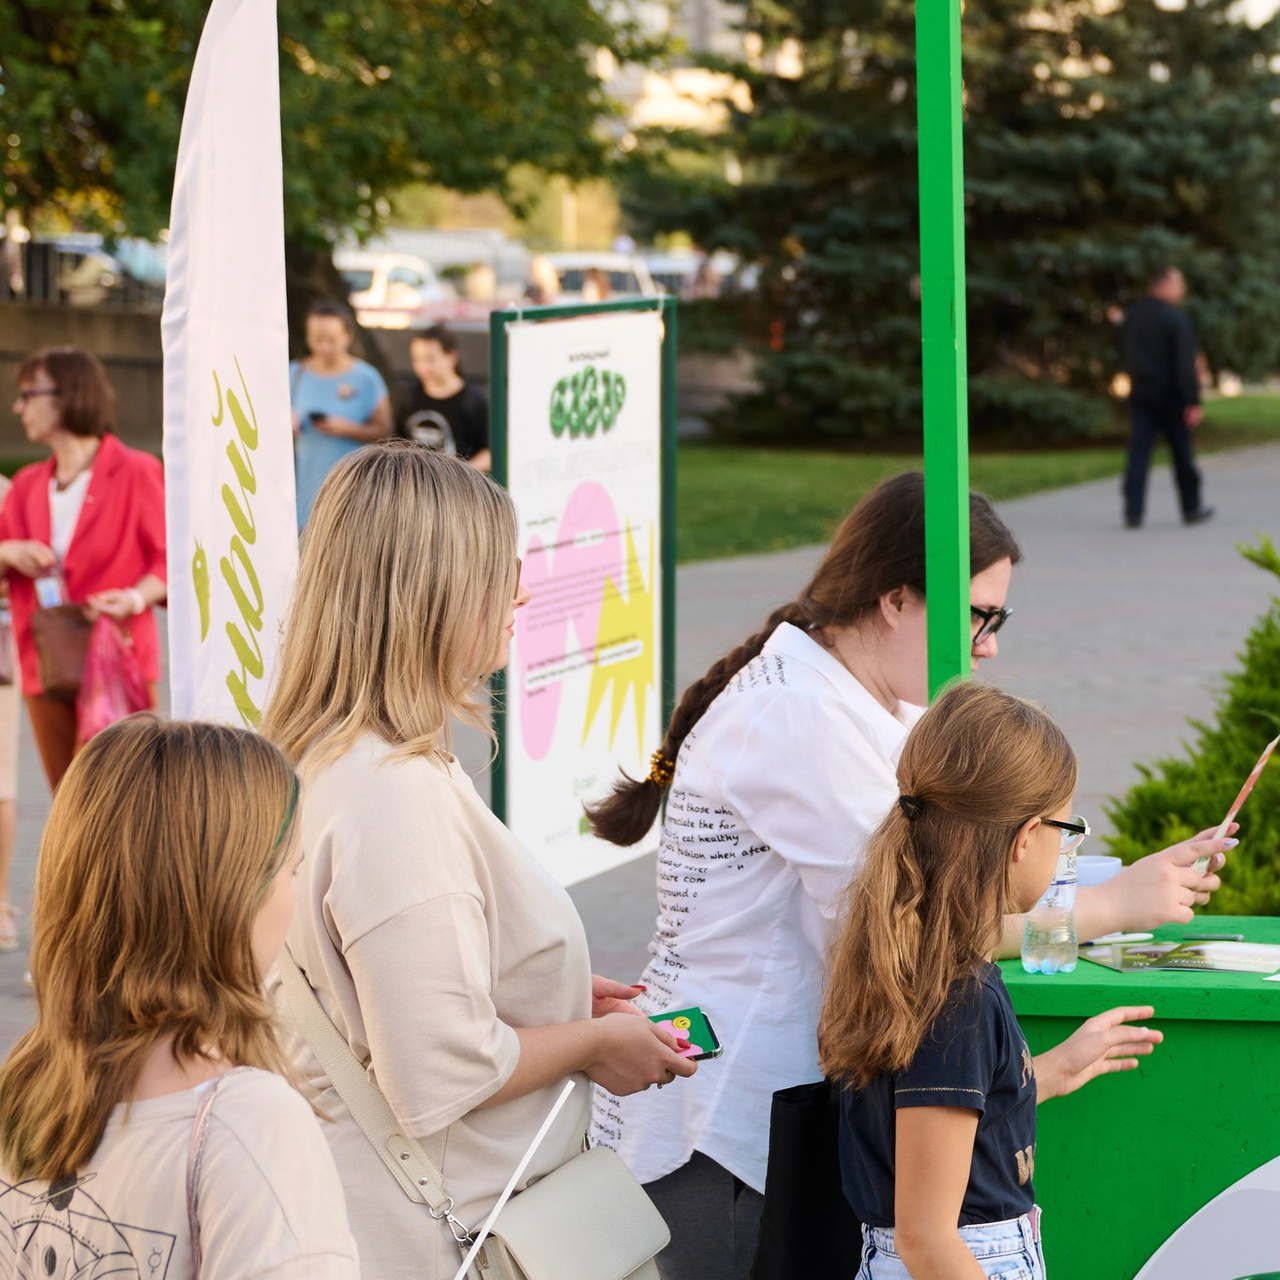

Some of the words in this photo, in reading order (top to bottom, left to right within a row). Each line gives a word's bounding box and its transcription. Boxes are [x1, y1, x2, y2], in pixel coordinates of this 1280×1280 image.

[686, 802, 710, 815] those
[714, 805, 734, 817] who
[698, 819, 715, 830] the
[681, 835, 696, 843] eat
[698, 834, 740, 847] healthy
[709, 850, 737, 860] when
